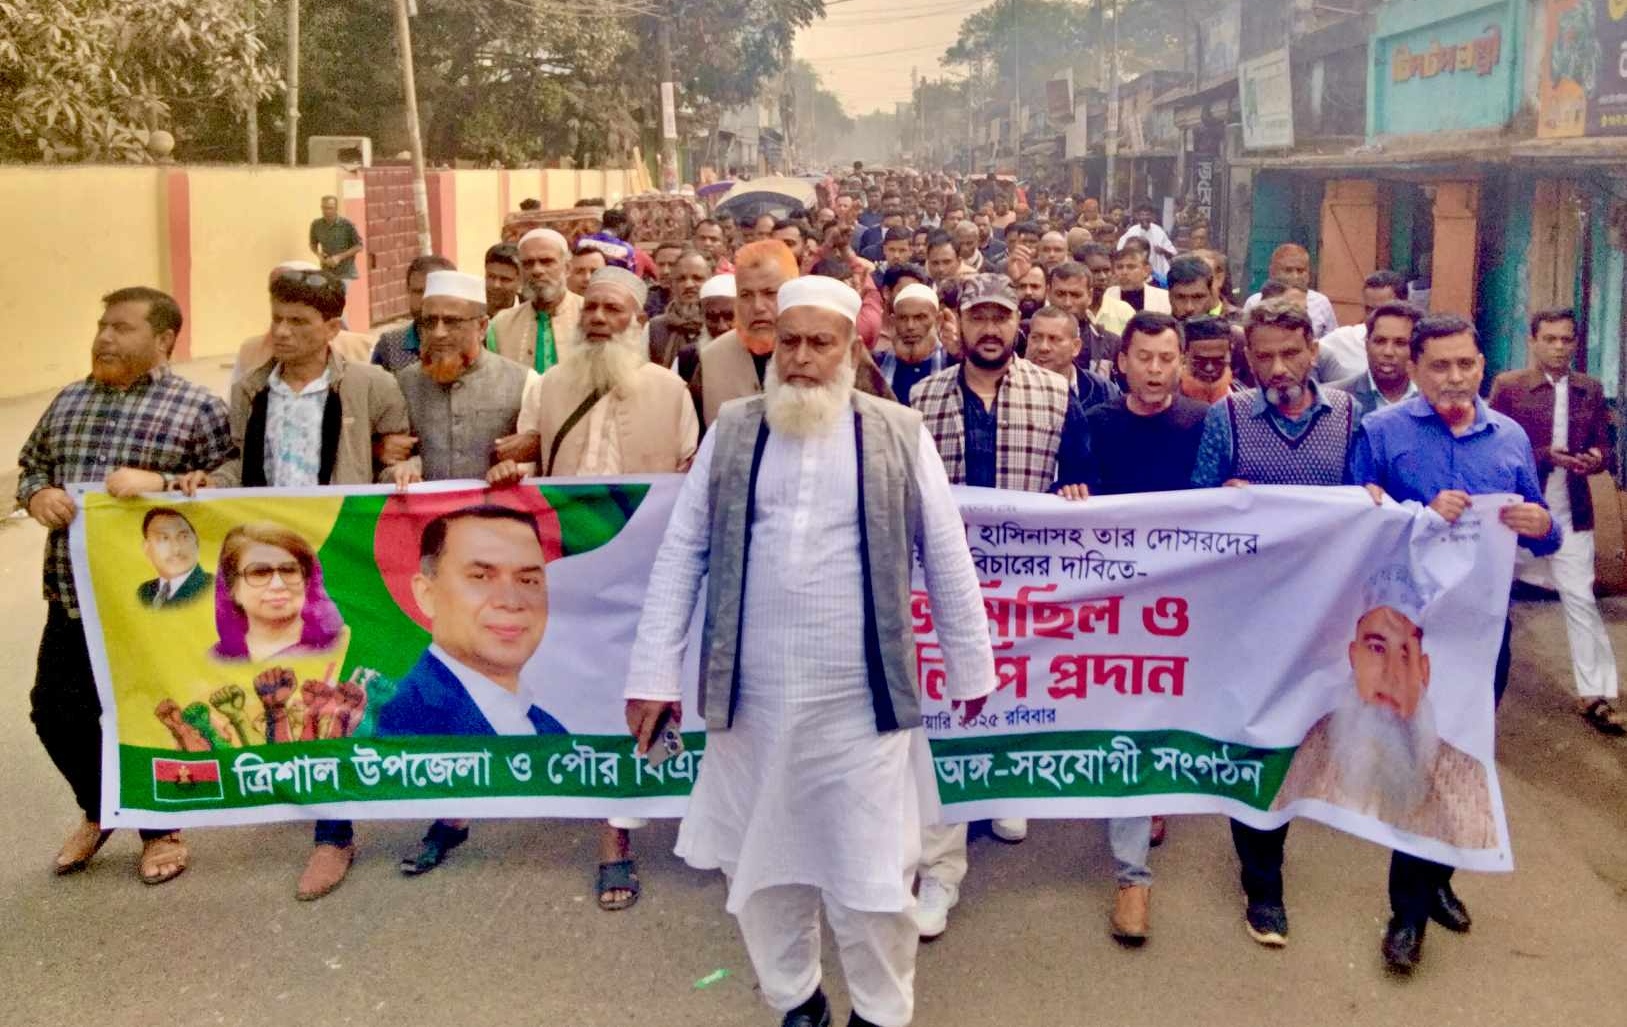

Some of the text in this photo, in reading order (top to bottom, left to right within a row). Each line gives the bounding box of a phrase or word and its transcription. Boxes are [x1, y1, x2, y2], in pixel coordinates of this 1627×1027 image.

[976, 521, 1260, 556] হাসিনাসহ তার দোসরদের
[1058, 548, 1149, 581] দাবিতে-
[1141, 597, 1190, 638] ও
[1047, 653, 1190, 700] প্রদান
[1004, 704, 1057, 726] রবিবার
[231, 752, 341, 797] ত্রিশাল
[350, 743, 493, 788] উপজেলা
[505, 752, 533, 783] ও
[547, 739, 622, 787] পৌর
[1151, 744, 1265, 798] সংগঠন
